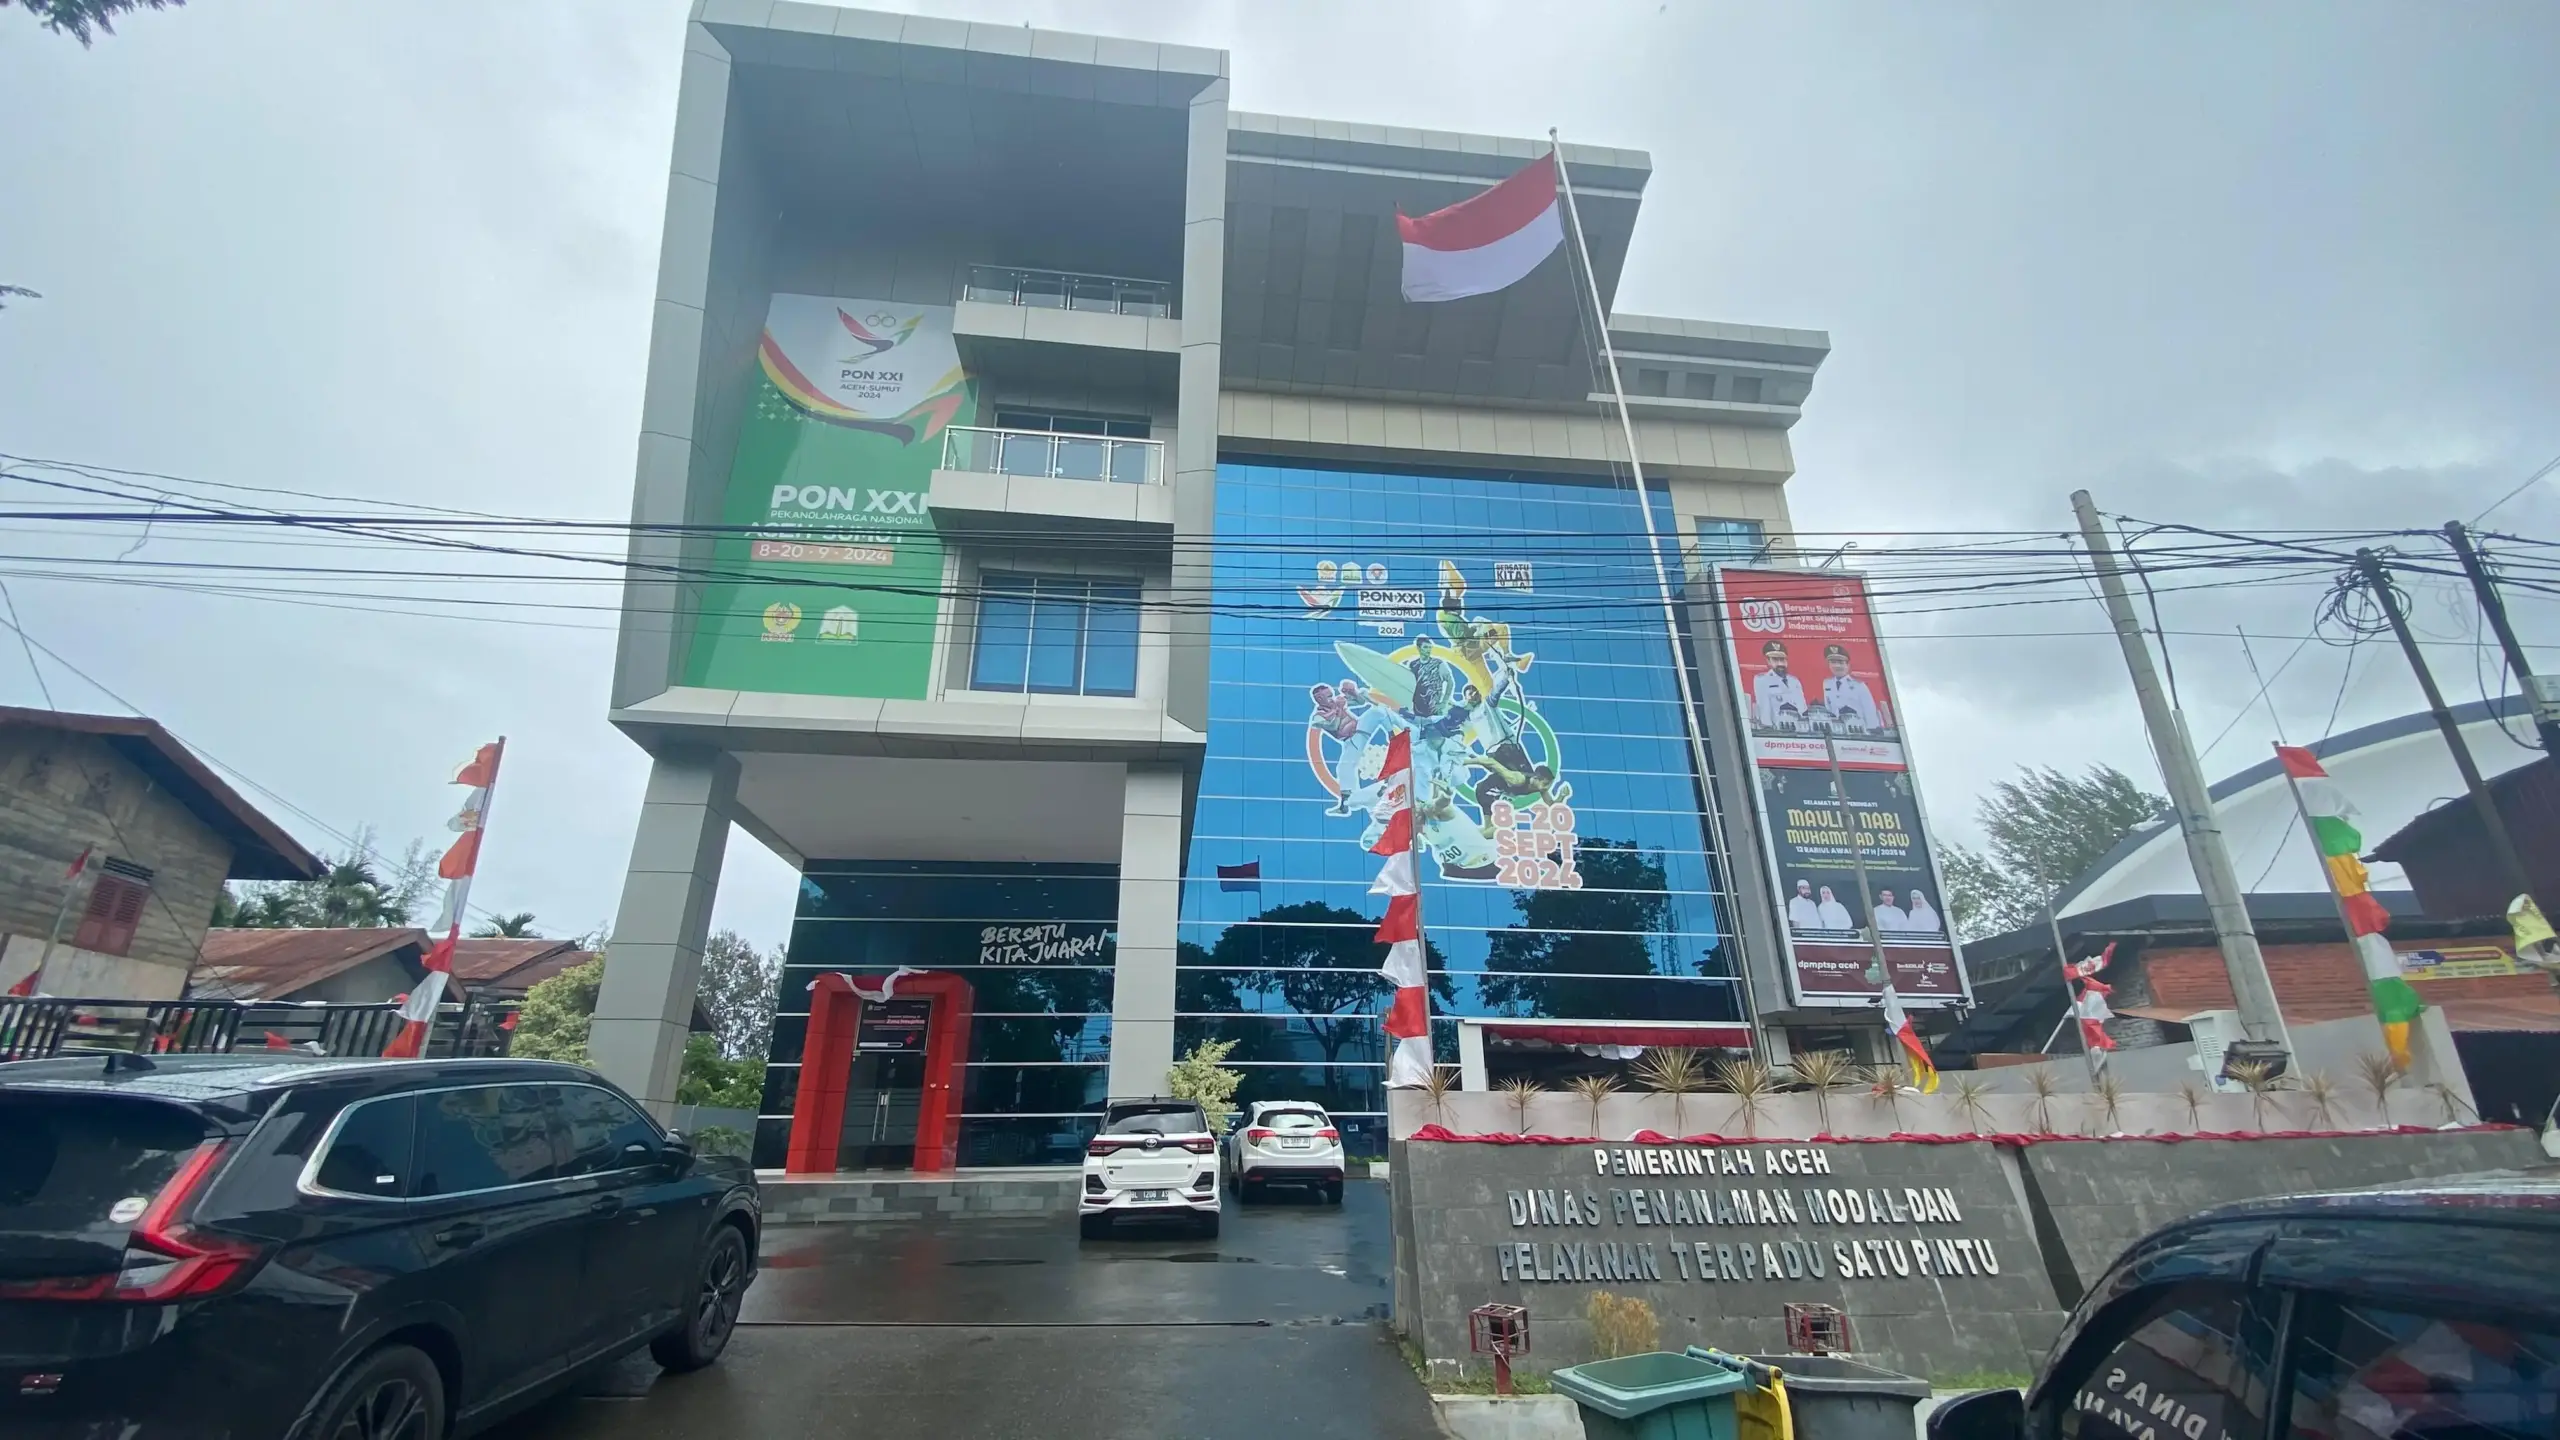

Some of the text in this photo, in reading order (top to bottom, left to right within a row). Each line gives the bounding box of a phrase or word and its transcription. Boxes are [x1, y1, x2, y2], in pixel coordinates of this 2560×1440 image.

[841, 370, 903, 382] PON XXI
[858, 391, 881, 399] 2024
[770, 485, 929, 514] PON XXI
[870, 516, 923, 525] NASIONAL
[843, 547, 887, 561] 2024
[1361, 591, 1392, 602] PON
[1380, 626, 1403, 635] 2024
[1764, 741, 1806, 751] dpmptsp
[1493, 802, 1574, 832] 8-20
[1859, 812, 1902, 830] NABI
[1496, 830, 1577, 860] SEPT
[1878, 832, 1910, 848] SAW
[1439, 845, 1462, 863] 260
[1497, 858, 1582, 888] 2024
[980, 923, 1066, 944] BERSATU
[980, 928, 1108, 964] KITA JUARA!
[1798, 960, 1860, 971] dpmptsp aceh
[1594, 1149, 1831, 1176] PEMERINTAH ACEH
[1507, 1187, 1962, 1226] DINAS PENANAMAN MODAL DAN
[1498, 1238, 2000, 1281] PELAYANAN TERPADU SATU PINTU
